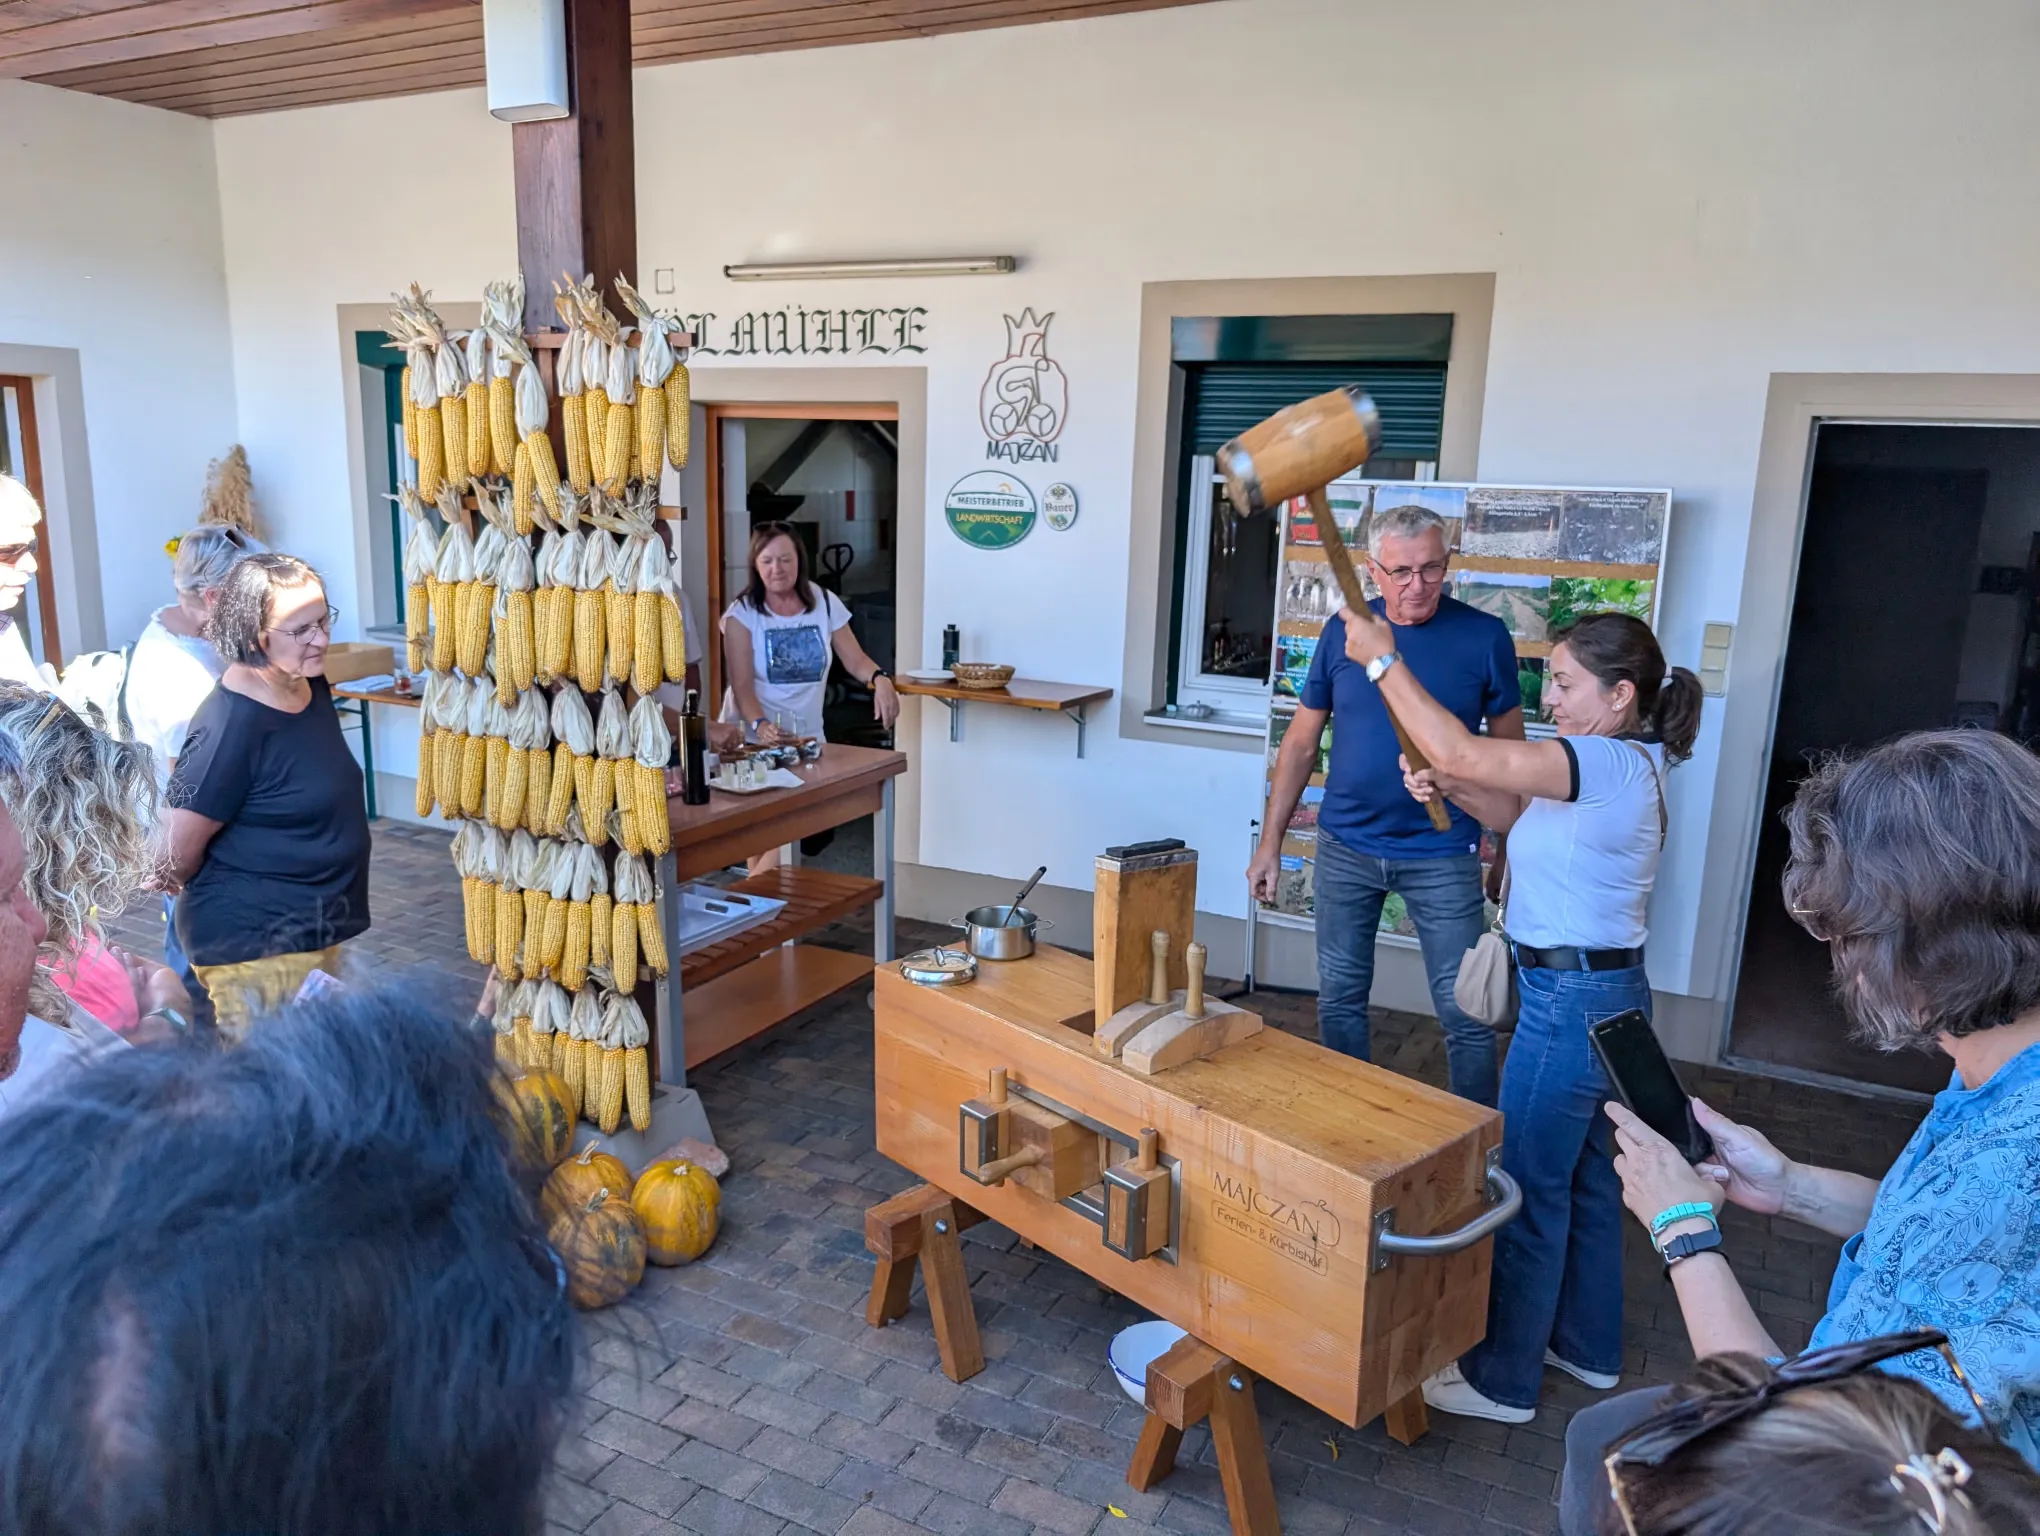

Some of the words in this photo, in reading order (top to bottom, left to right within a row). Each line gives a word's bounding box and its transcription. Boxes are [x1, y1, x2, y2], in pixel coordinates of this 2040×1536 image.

[957, 496, 1025, 508] MEISTERBETRIEB
[1045, 502, 1074, 513] Bauer
[955, 513, 1024, 525] LANDWIRTSCHAFT
[1213, 1171, 1320, 1239] MAJCZAN
[1216, 1206, 1257, 1234] Ferien-
[1258, 1228, 1268, 1241] &
